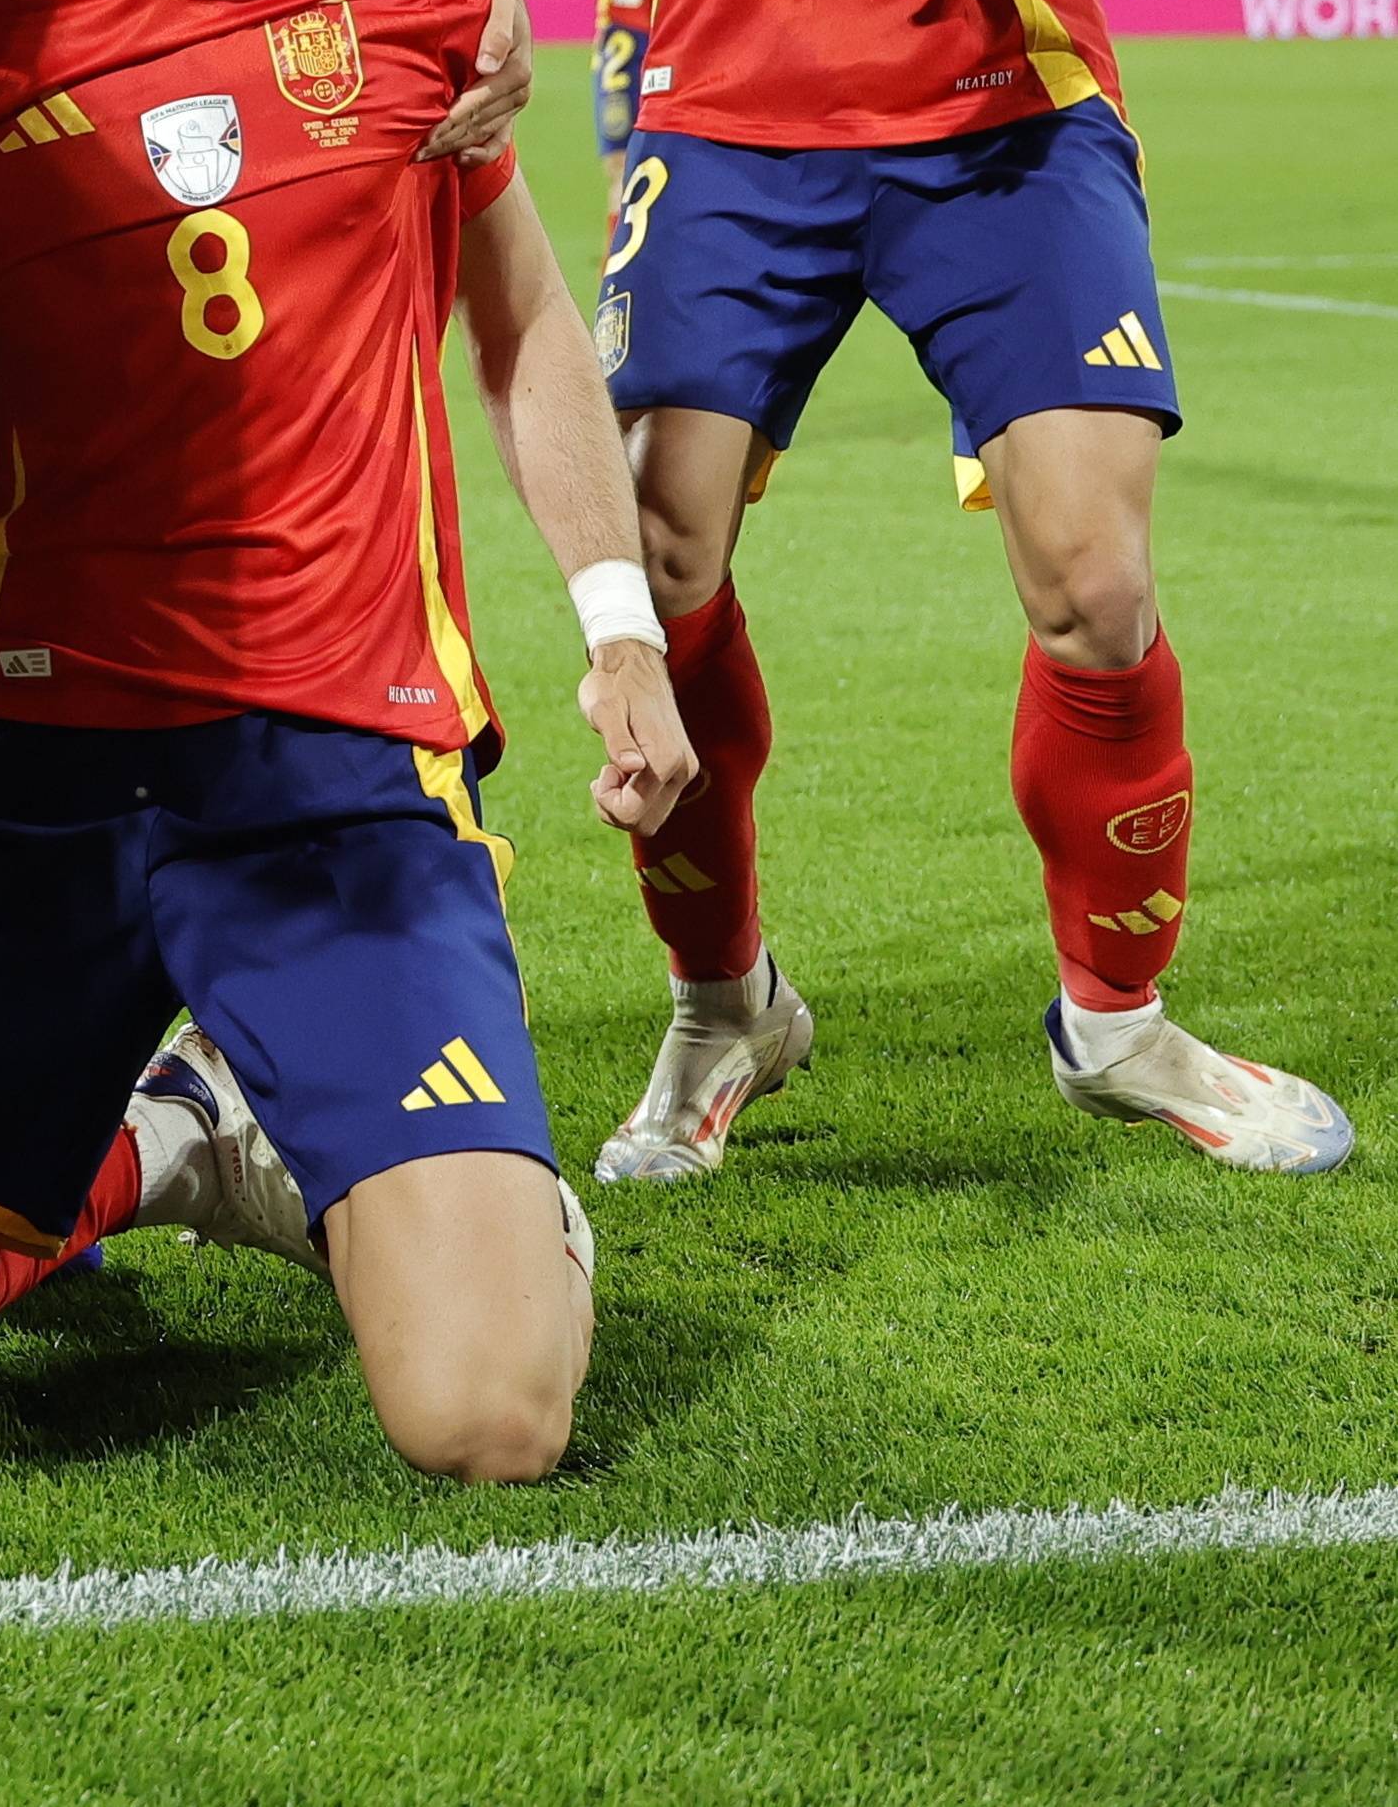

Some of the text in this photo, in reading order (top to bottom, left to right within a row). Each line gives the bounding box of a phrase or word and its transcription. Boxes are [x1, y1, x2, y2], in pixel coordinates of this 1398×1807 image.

[601, 155, 670, 278] 3
[166, 207, 266, 361] 8
[232, 1144, 244, 1185] COPA
